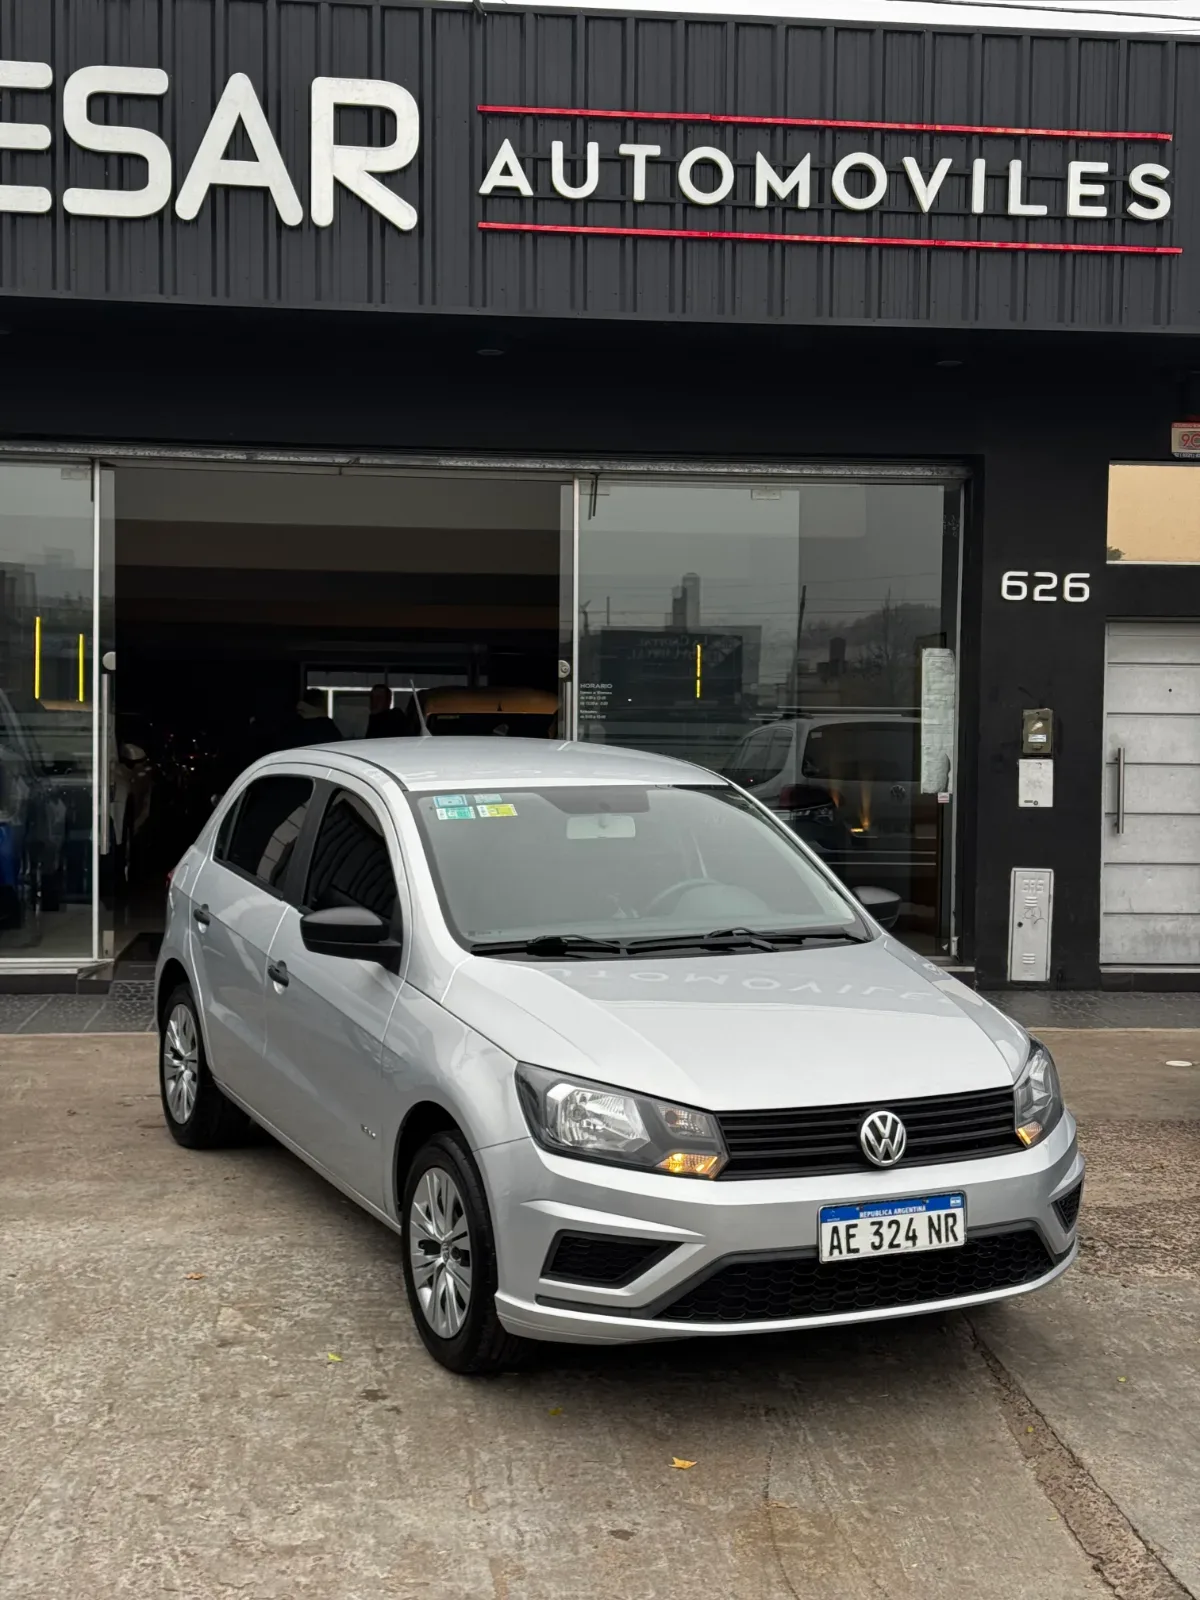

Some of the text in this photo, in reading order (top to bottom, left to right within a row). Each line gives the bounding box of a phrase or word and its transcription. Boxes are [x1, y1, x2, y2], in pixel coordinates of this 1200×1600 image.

[478, 138, 1172, 221] AUTOMOVILES
[1001, 571, 1091, 602] 626
[859, 1205, 926, 1218] REPUBLICA ARGENTINA
[829, 1212, 959, 1256] AE 324 NR
